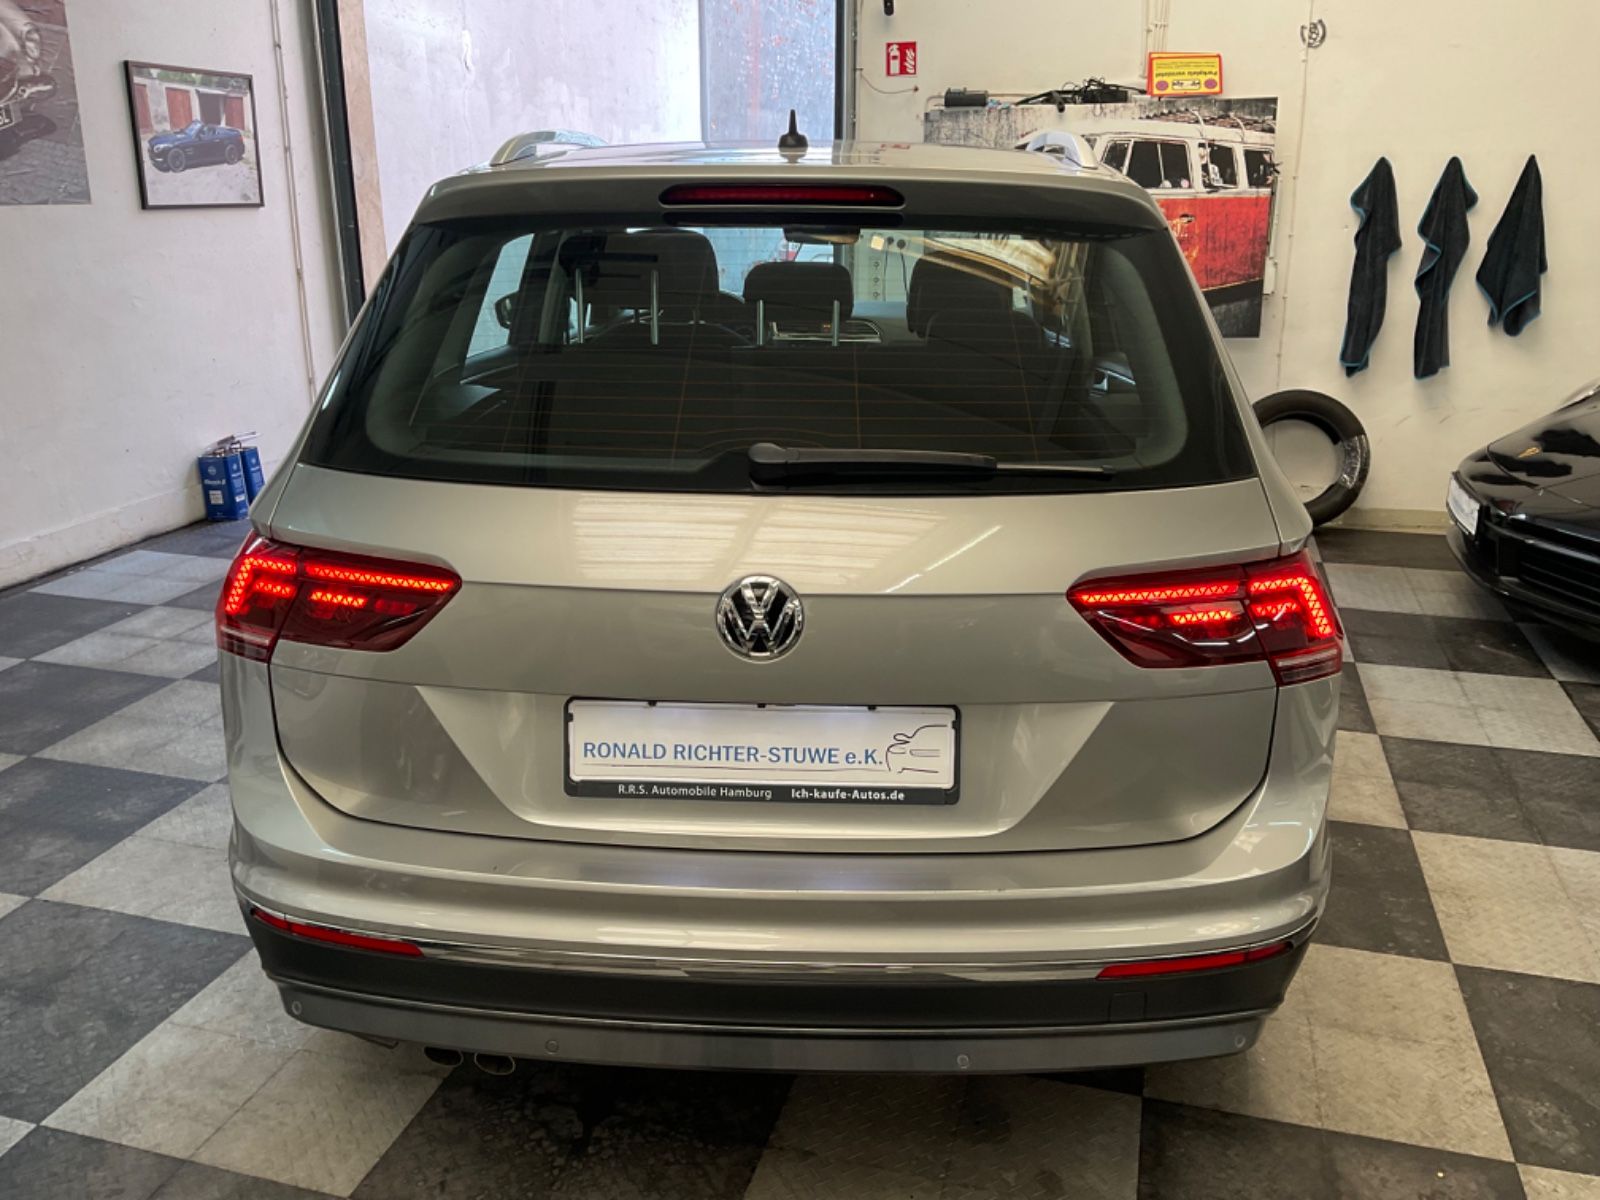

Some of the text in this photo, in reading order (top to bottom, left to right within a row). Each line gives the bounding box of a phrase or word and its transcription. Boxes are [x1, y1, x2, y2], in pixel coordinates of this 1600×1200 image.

[583, 742, 883, 765] RONALD RICHTER-STUWE e.K.
[618, 784, 905, 801] R.R.S. Automobile Hamburg Ich-kaufe-Autos.de
